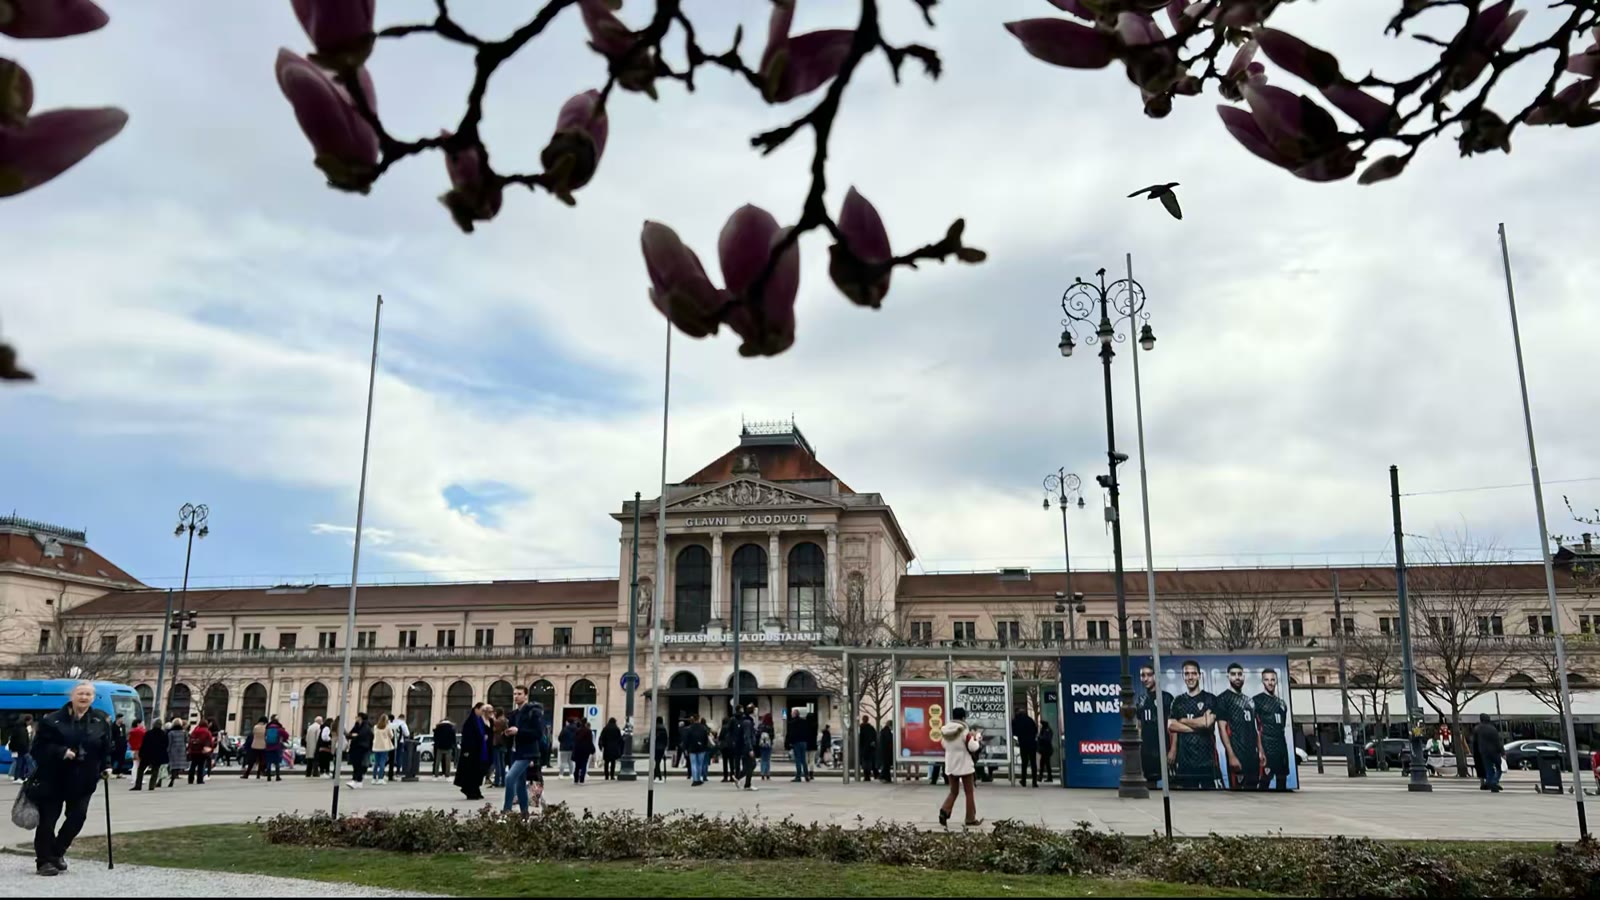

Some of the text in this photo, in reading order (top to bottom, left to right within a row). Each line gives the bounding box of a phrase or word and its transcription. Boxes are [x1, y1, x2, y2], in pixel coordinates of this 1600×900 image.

[685, 514, 808, 527] GLAVNI KOLODVOR
[664, 633, 719, 643] PREKASNO
[751, 632, 822, 642] ODUSTAJANJE
[967, 686, 1004, 694] EDWARD
[985, 703, 1005, 711] 2023
[1073, 698, 1123, 713] NA NAŠ
